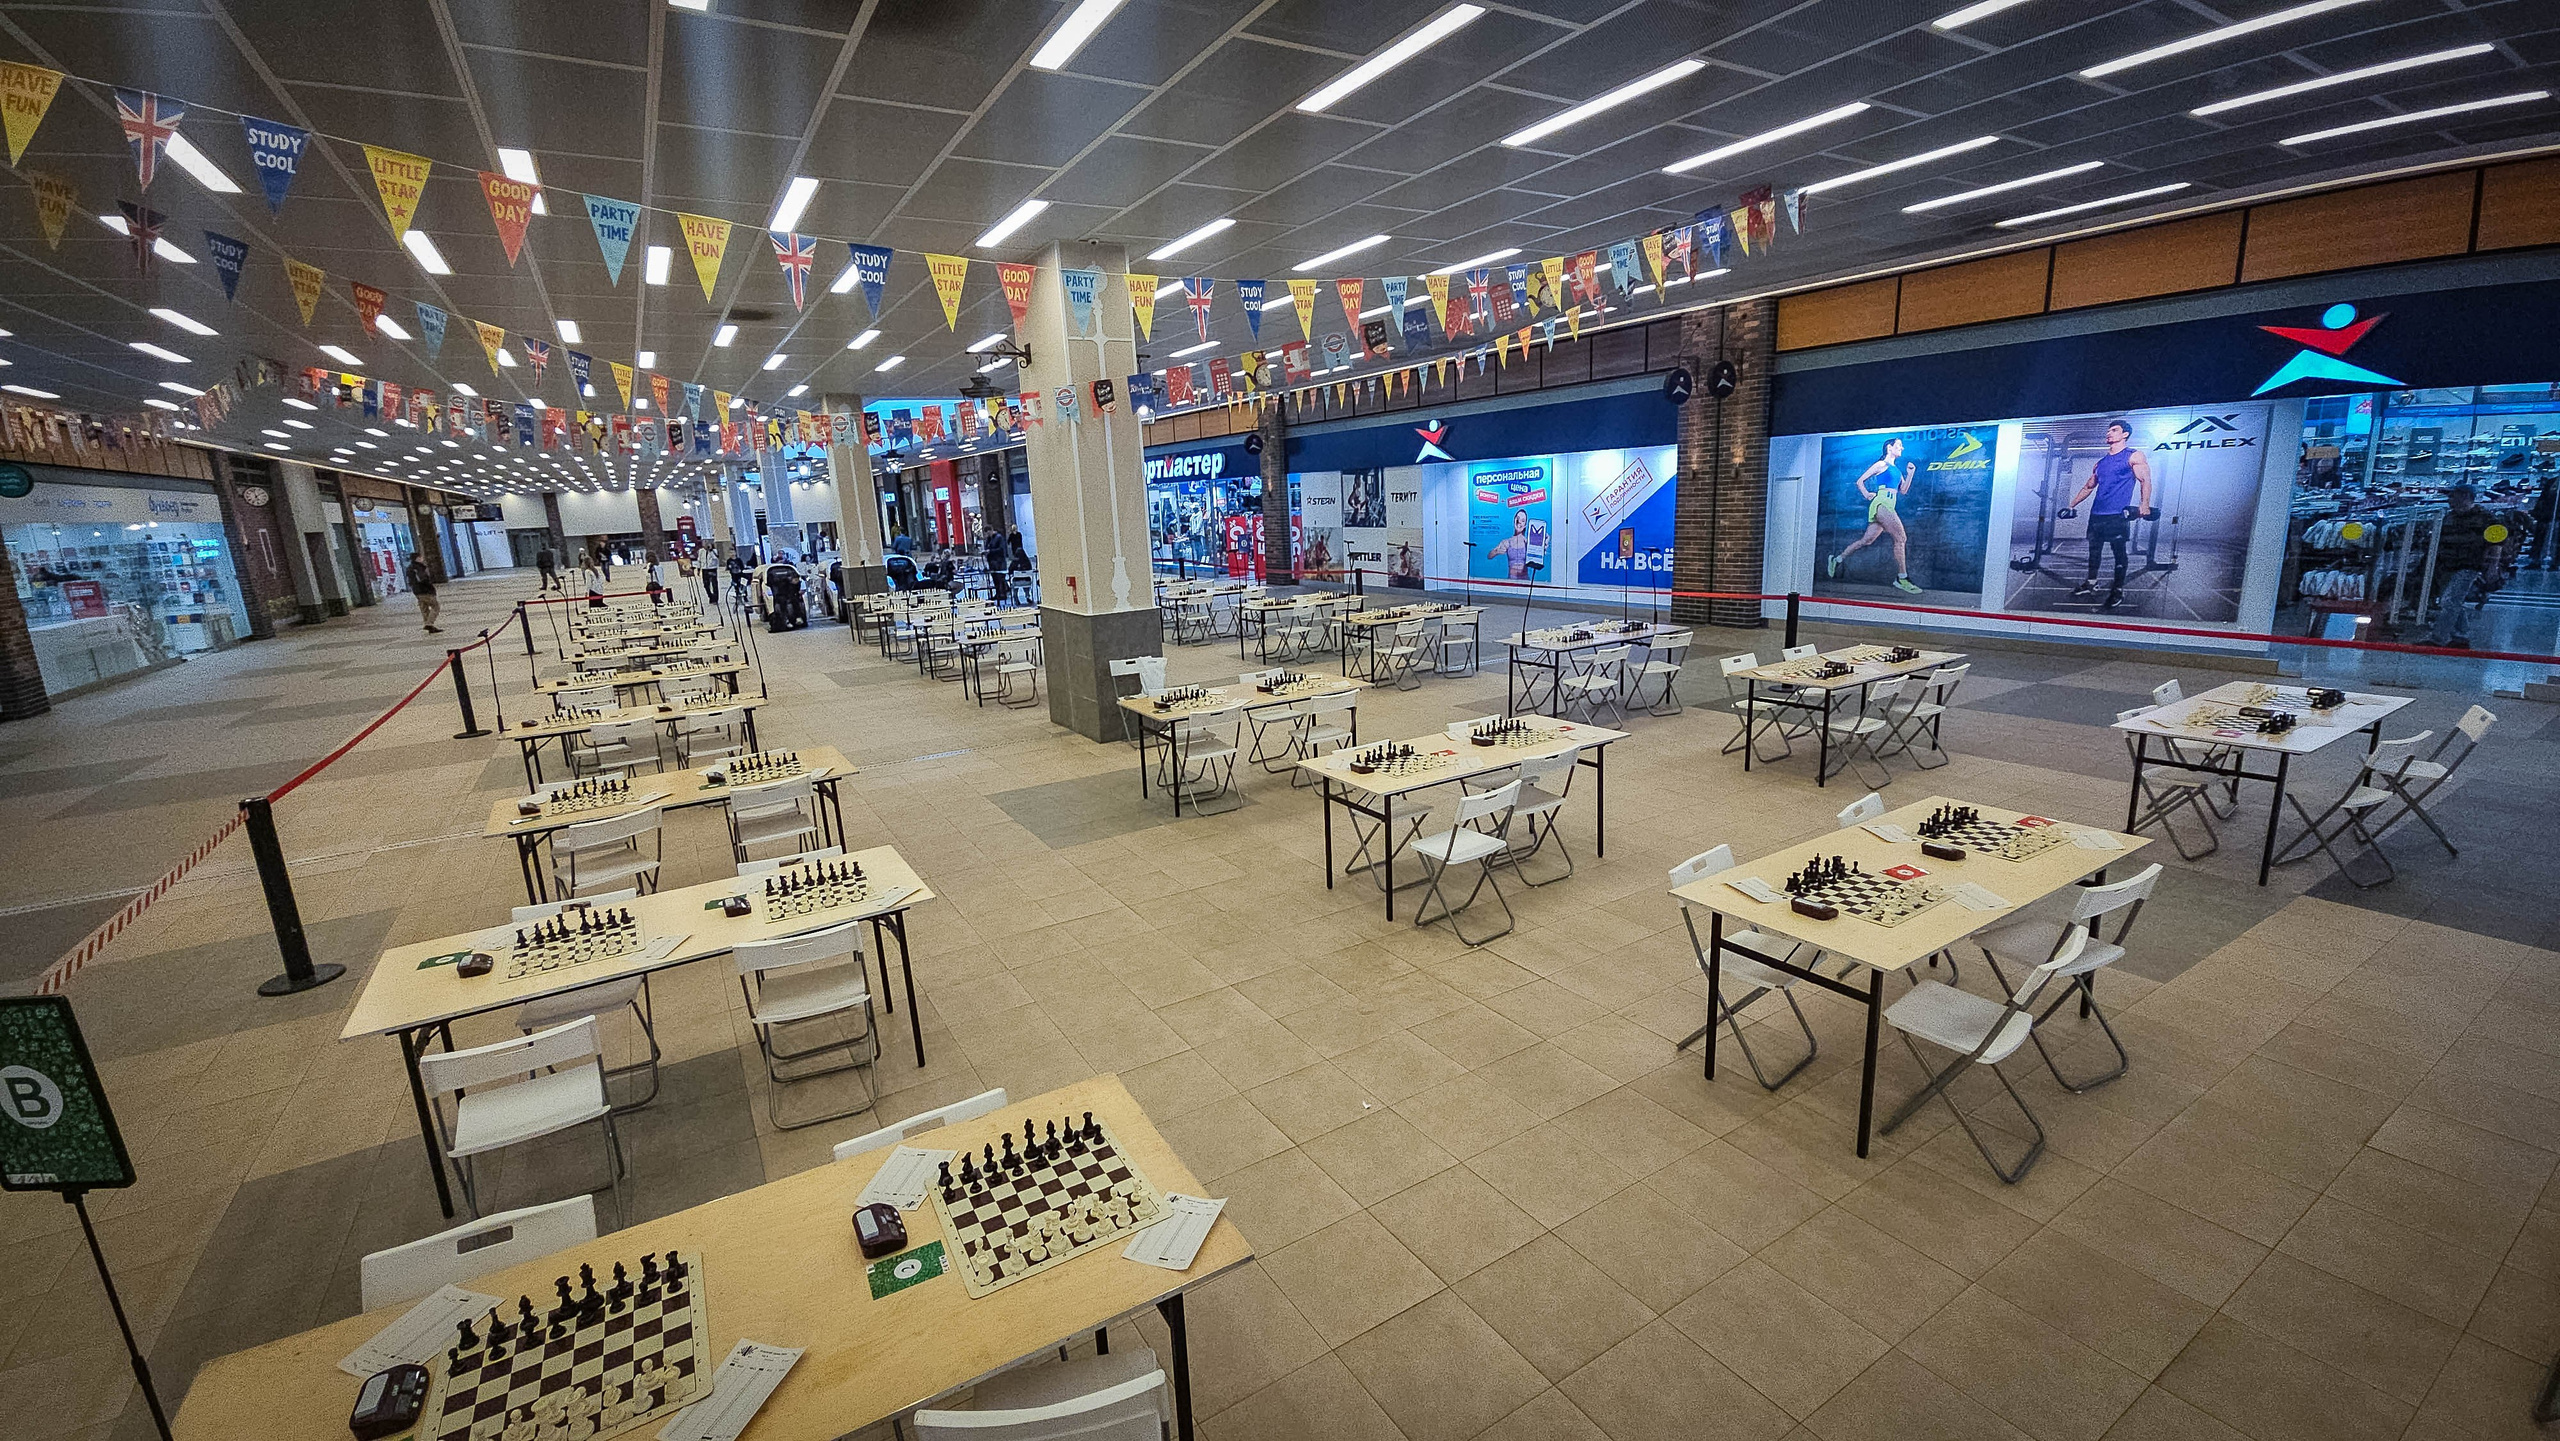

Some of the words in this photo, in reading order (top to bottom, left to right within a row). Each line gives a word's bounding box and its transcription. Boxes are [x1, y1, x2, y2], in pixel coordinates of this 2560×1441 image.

[248, 128, 301, 153] STUDY
[254, 151, 296, 175] COOL
[373, 157, 423, 182] LITTLE
[379, 178, 418, 199] STAR
[490, 179, 531, 202] GOOD
[494, 200, 526, 224] DAY
[590, 204, 636, 225] PARTY
[599, 223, 629, 243] TIME
[686, 222, 724, 241] HAVE
[210, 239, 244, 258] STUDY
[693, 242, 720, 258] FUN
[214, 255, 240, 273] COOL
[853, 251, 887, 270] STUDY
[859, 268, 885, 285] COOL
[932, 262, 963, 277] LITTLE
[1003, 268, 1030, 284] GOOD
[1508, 270, 1526, 282] STUDY
[1581, 268, 1594, 279] DAY
[936, 278, 962, 291] STAR
[1066, 274, 1095, 288] PARTY
[1129, 279, 1154, 293] HAVE
[1340, 281, 1360, 296] GOOD
[1386, 281, 1406, 293] PARTY
[1428, 278, 1447, 289] HAVE
[1512, 280, 1527, 292] COOL
[1006, 285, 1028, 302] DAY
[1071, 290, 1092, 304] TIME
[1241, 286, 1263, 298] STUDY
[1292, 285, 1314, 297] LITTLE
[359, 301, 379, 314] DAY
[1134, 295, 1153, 308] FUN
[1244, 300, 1262, 312] COOL
[1344, 297, 1360, 310] DAY
[2153, 437, 2258, 451] ATHLEX
[1926, 459, 1992, 471] DEMIX
[1476, 469, 1540, 485] персональная
[1511, 483, 1528, 493] цена
[1606, 467, 1643, 503] ГАРАНТИЯ
[1312, 497, 1336, 505] STERN
[1349, 552, 1382, 562] ETTLER
[1601, 552, 1629, 569] НА
[1634, 548, 1675, 571] ВСЁ
[4, 1077, 51, 1118] B
